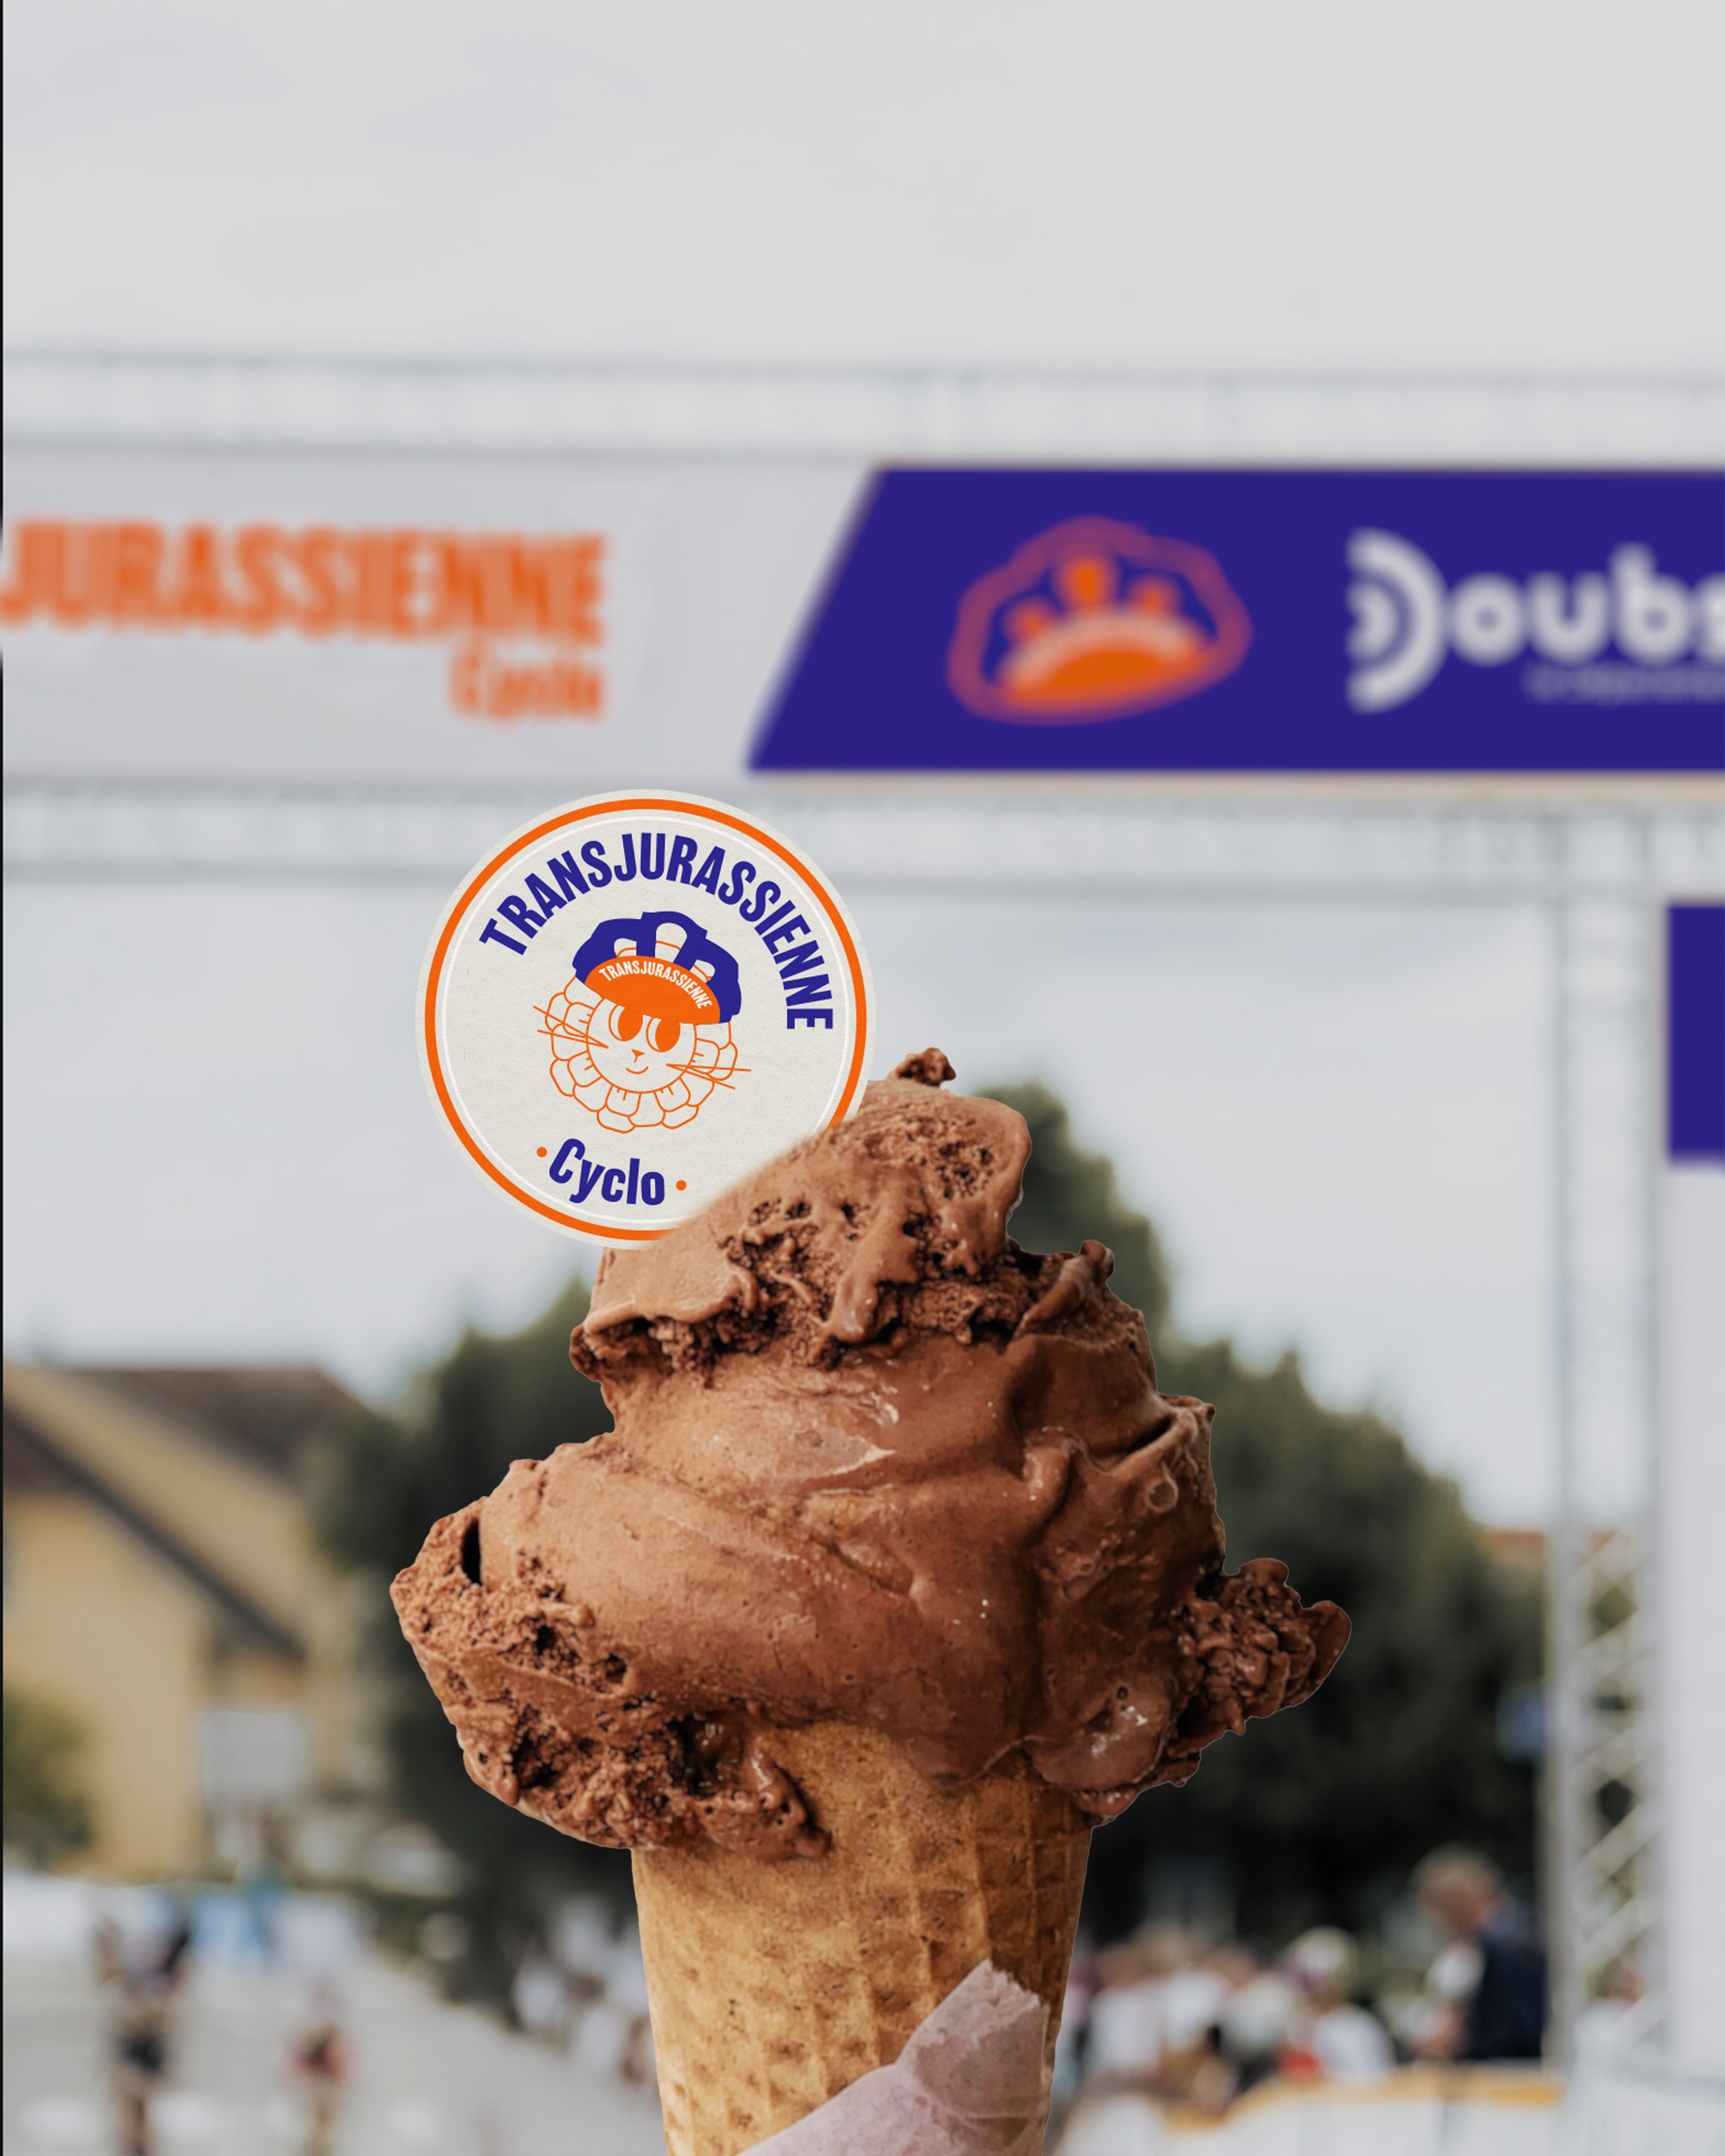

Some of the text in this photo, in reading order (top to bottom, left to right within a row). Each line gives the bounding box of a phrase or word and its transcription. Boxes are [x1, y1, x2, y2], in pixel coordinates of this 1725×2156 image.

[479, 833, 833, 1030] TRANSJURASSIENNE
[598, 960, 713, 1009] TRANSJURASSIENNE
[549, 1138, 665, 1205] Cyclo
